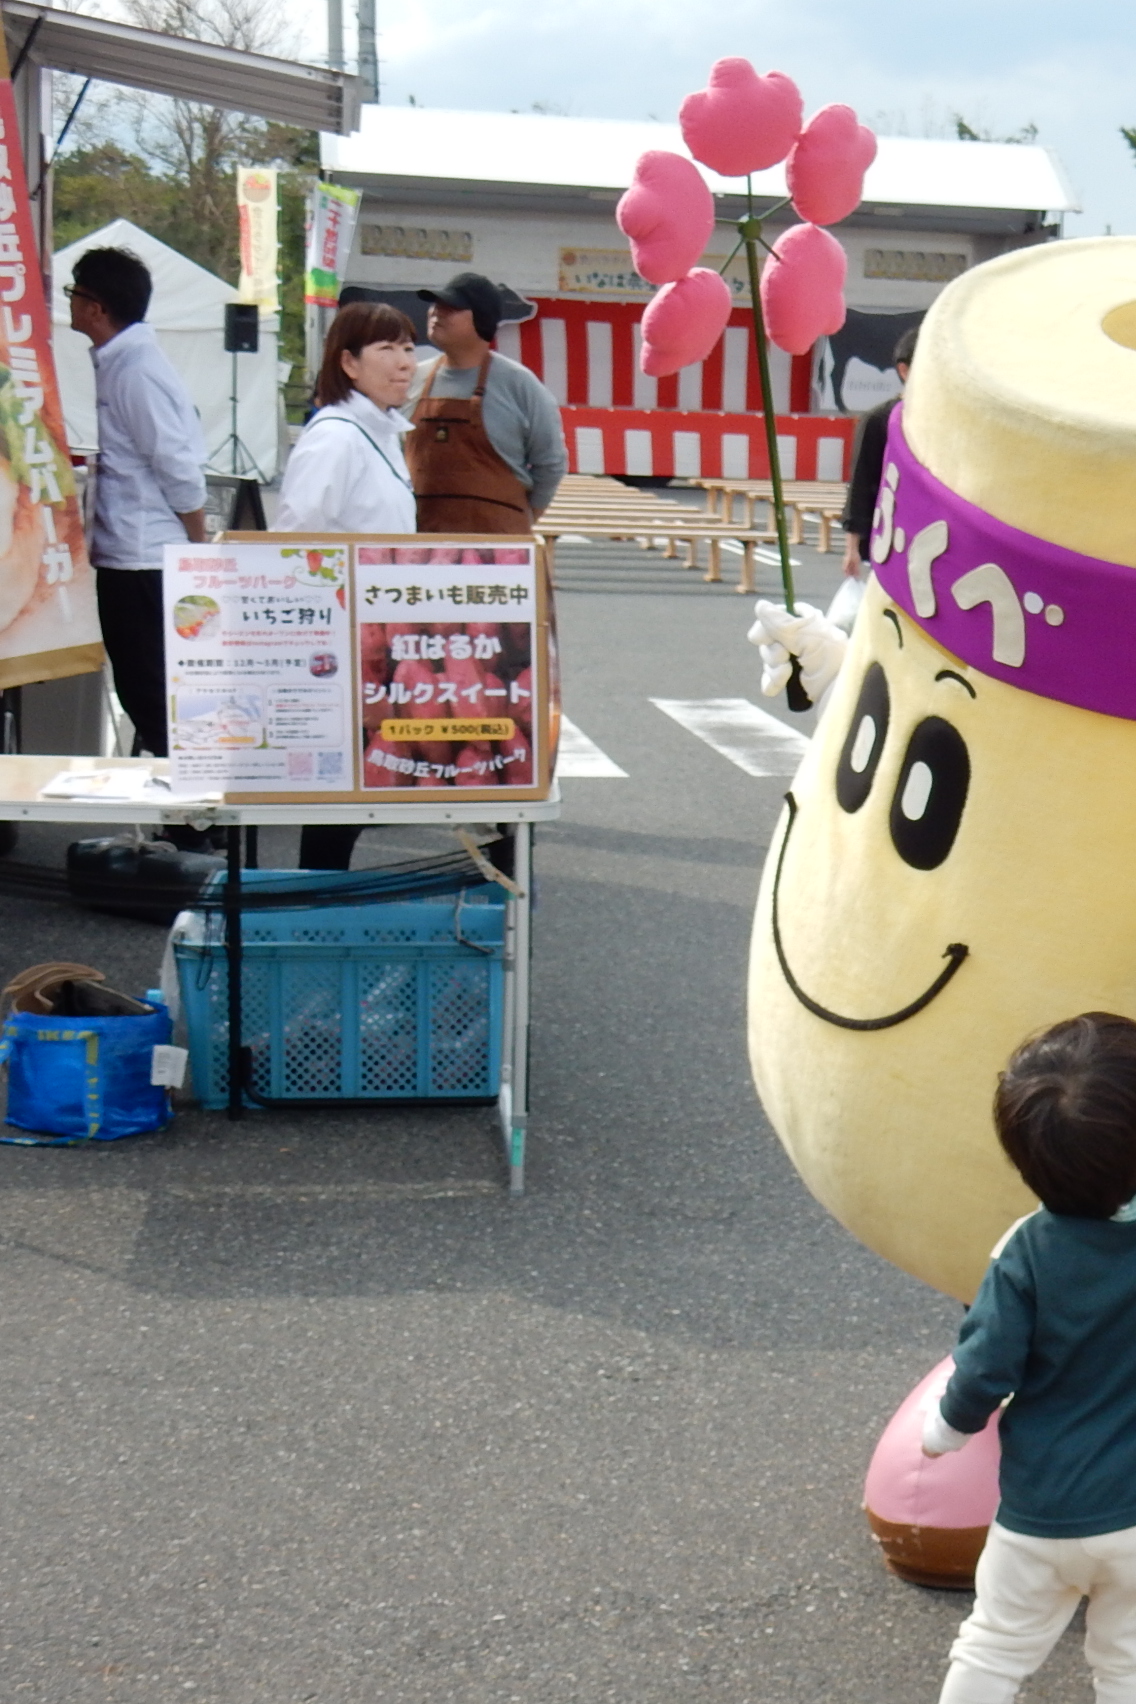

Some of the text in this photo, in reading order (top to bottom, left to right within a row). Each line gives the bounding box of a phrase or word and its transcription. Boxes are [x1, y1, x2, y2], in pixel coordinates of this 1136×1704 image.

[193, 575, 298, 589] フルーツパーク
[364, 583, 529, 605] さつまいも販売中
[242, 607, 332, 625] いちご狩り
[391, 633, 503, 662] 紅はるか
[363, 681, 532, 704] シルクスイート
[389, 724, 434, 735] 1パック
